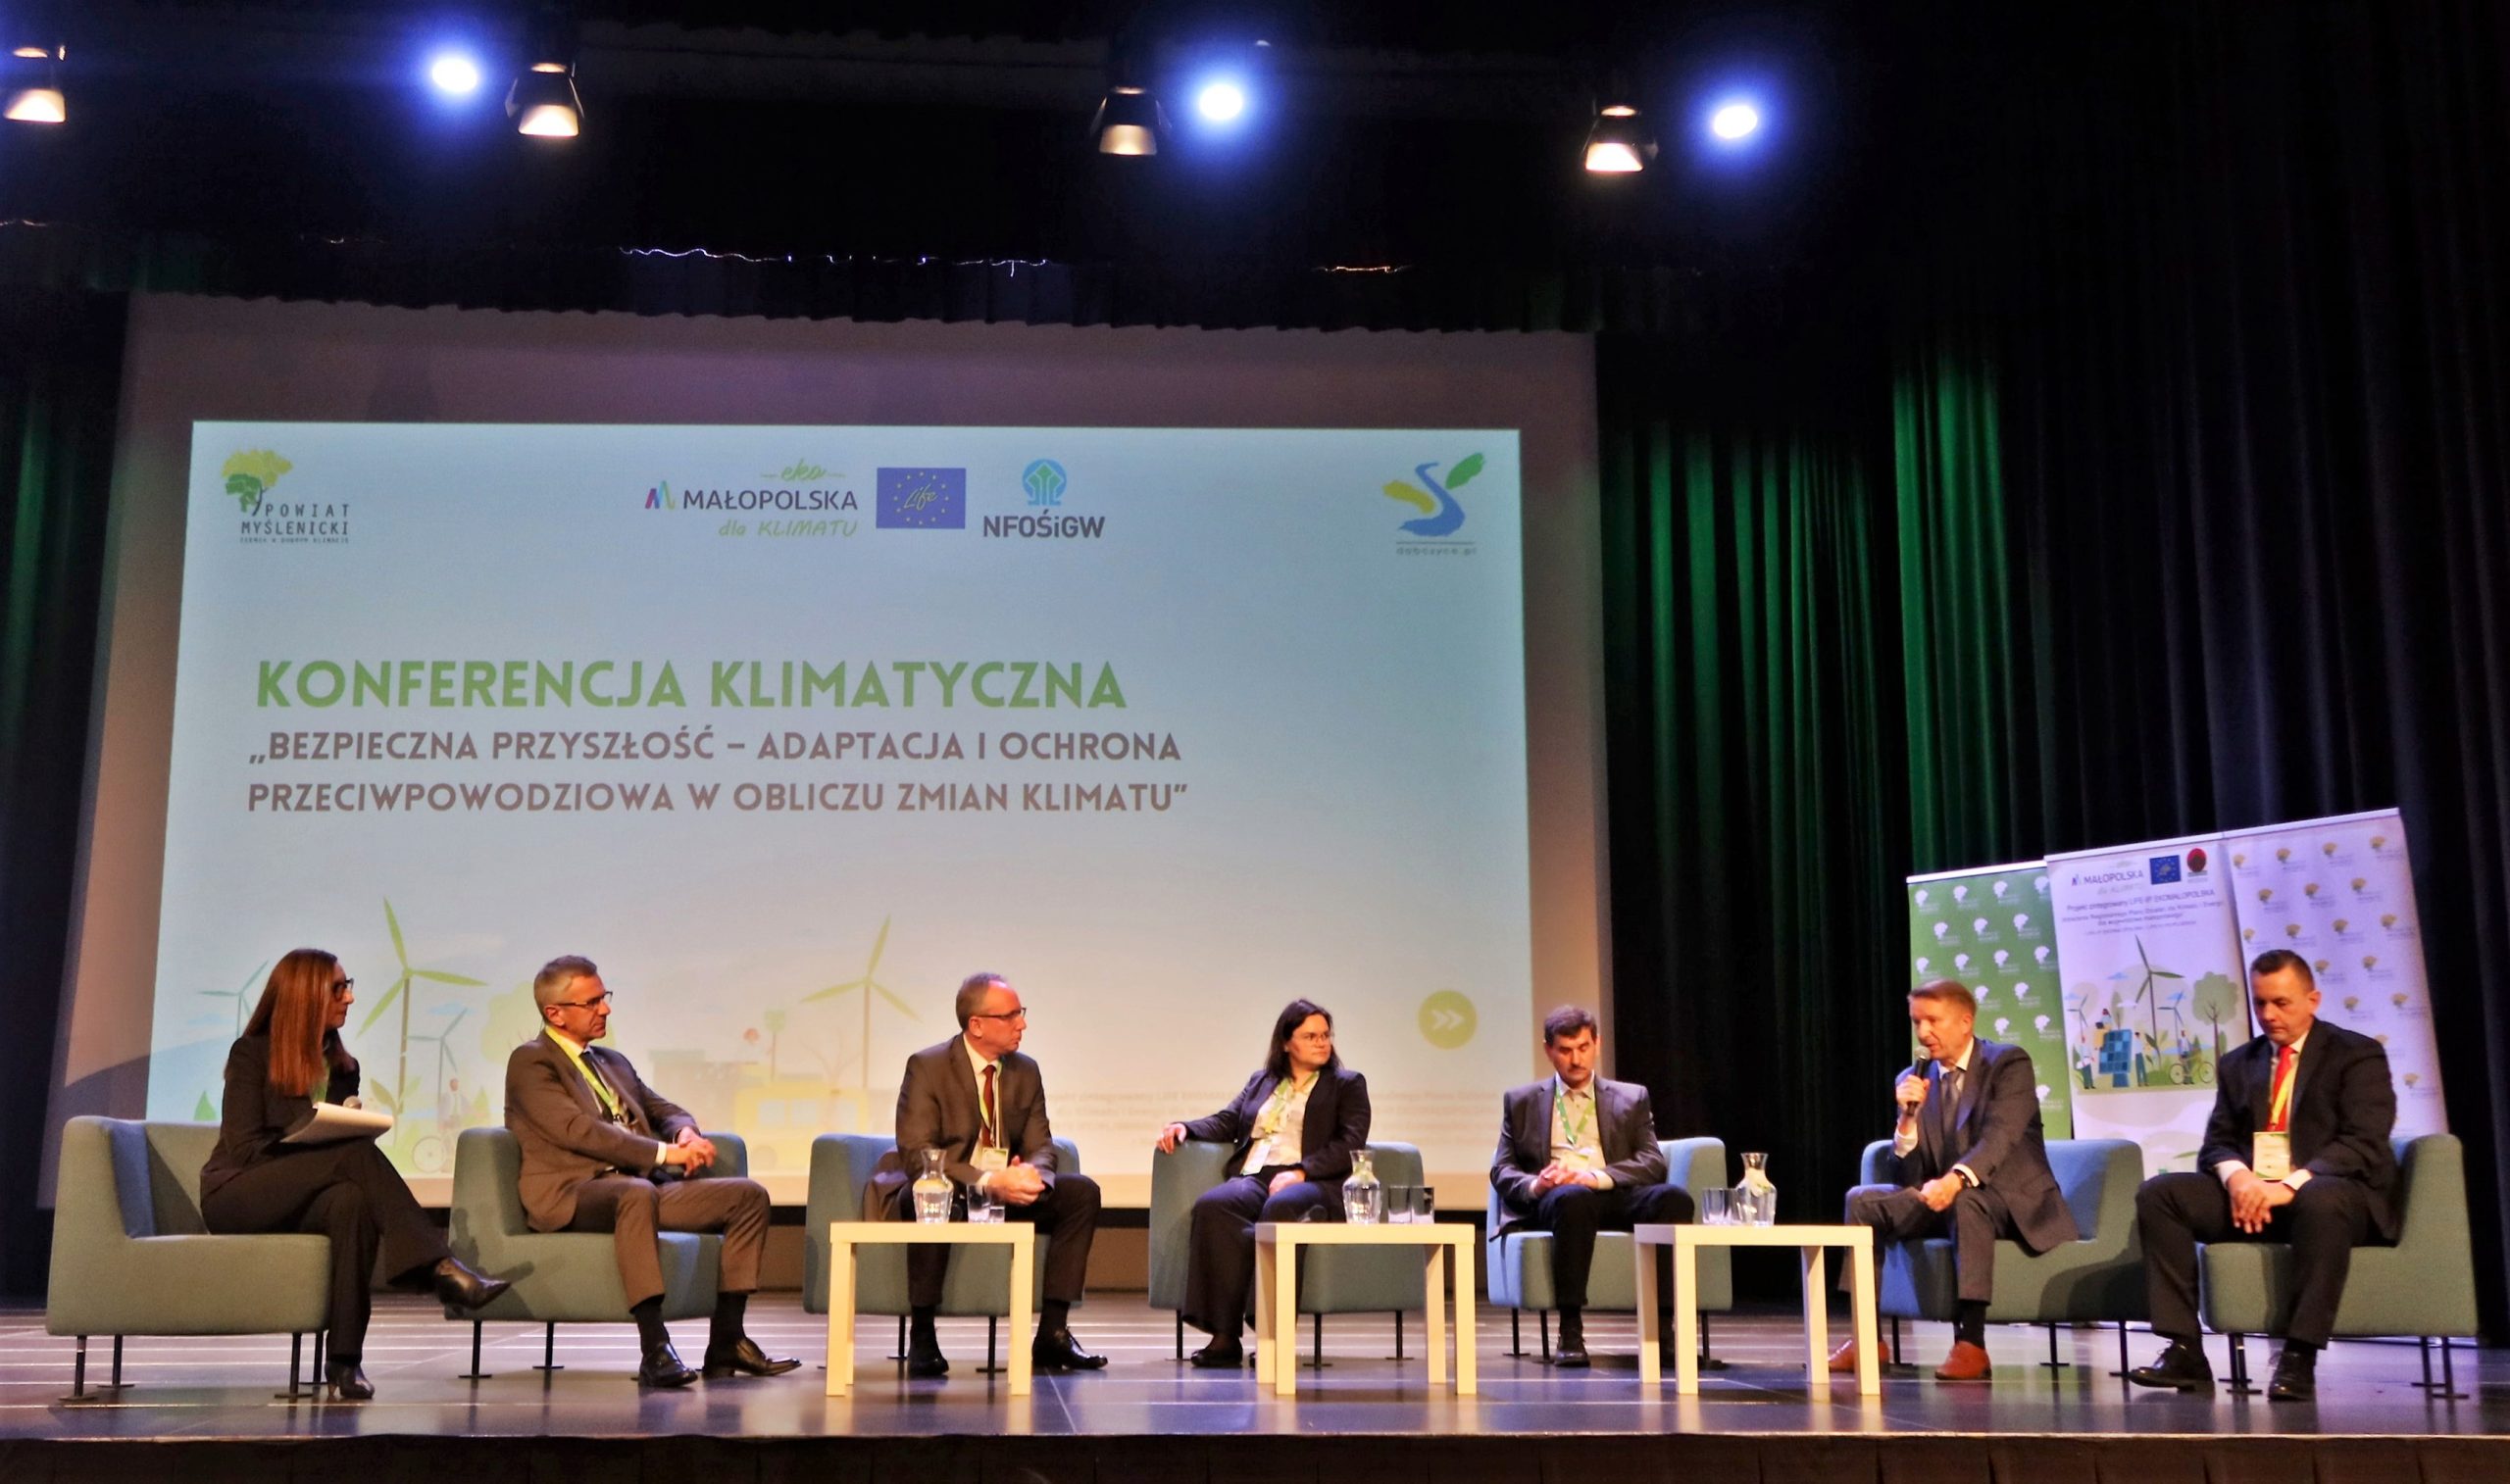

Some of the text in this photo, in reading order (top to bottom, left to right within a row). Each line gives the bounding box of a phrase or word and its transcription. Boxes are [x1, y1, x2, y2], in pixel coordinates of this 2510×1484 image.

[266, 503, 350, 518] POWIAT
[683, 489, 859, 511] MAŁOPOLSKA
[241, 519, 349, 535] MYŚLENICKI
[719, 519, 858, 538] dla KLIMATU
[983, 509, 1106, 538] NFOŚiGW
[257, 660, 1128, 709] KONFERENCJA KLIMATYCZNA
[249, 731, 478, 765] „BEZPIECZNA
[492, 724, 715, 760] PRZYSZŁOŚĆ
[757, 731, 965, 760] ADAPTACJA
[978, 732, 986, 760] I
[999, 731, 1182, 761] OCHRONA
[248, 783, 1188, 812] PRZECIWPOWODZIOWA W OBLICZU ZMIAN KLIMATU”
